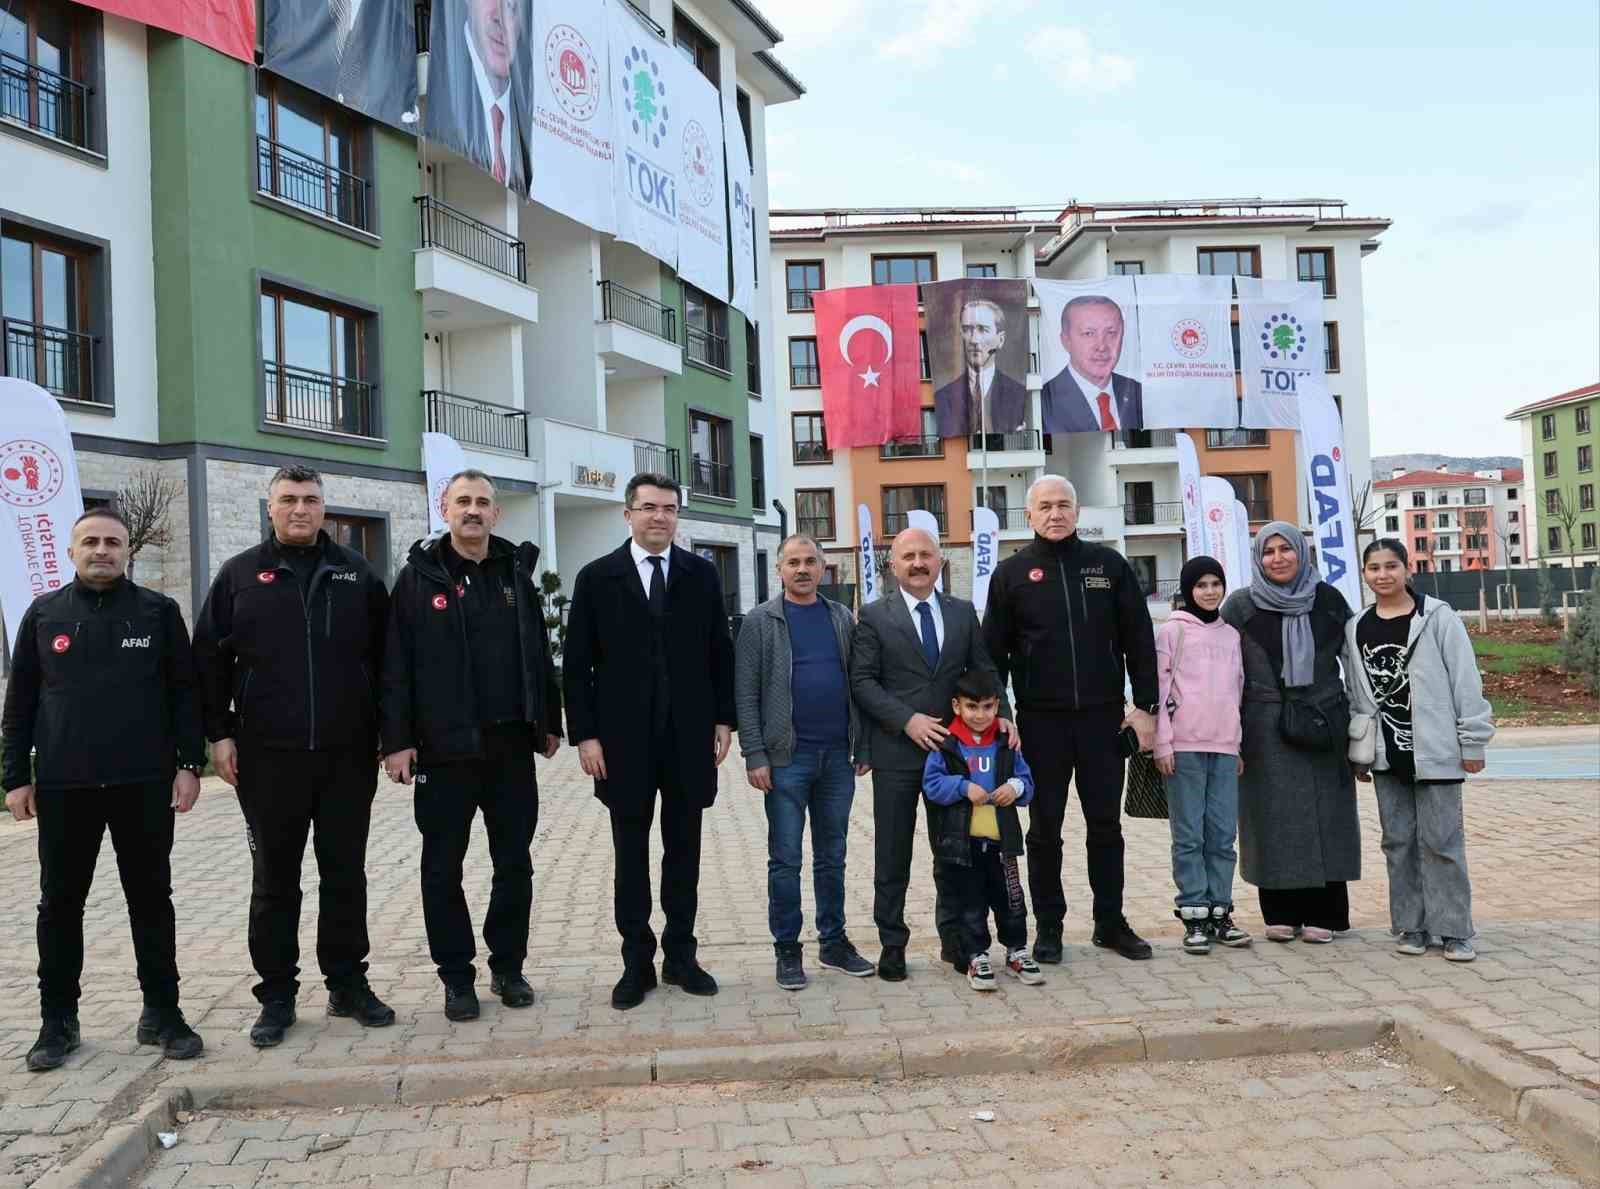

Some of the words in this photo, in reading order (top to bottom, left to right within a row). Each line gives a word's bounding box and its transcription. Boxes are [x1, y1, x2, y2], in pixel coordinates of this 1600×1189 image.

[1080, 567, 1104, 575] AFAD
[331, 572, 357, 582] AFAD
[121, 638, 150, 648] AFAD
